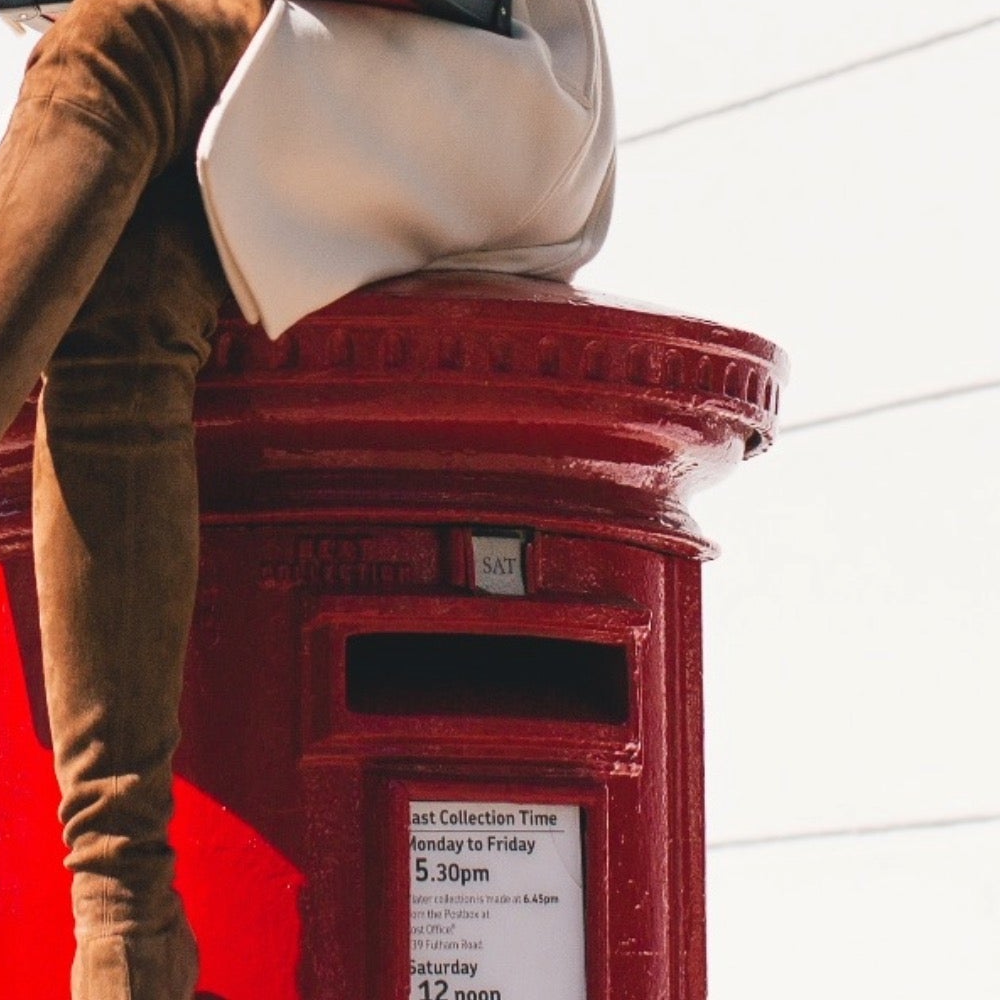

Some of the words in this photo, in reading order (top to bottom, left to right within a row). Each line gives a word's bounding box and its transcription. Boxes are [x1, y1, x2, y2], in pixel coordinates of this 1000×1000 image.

[482, 556, 517, 575] SAT
[412, 811, 436, 825] ast
[440, 809, 515, 826] Collection
[519, 810, 557, 826] Time
[468, 837, 483, 851] to
[488, 836, 535, 854] Friday
[415, 857, 490, 886] 5.30pm
[523, 893, 559, 906] 6.45pm
[427, 909, 442, 919] the
[411, 925, 424, 934] ost
[410, 959, 478, 978] Saturday
[418, 980, 449, 1000] 12
[455, 990, 502, 1000] noon
